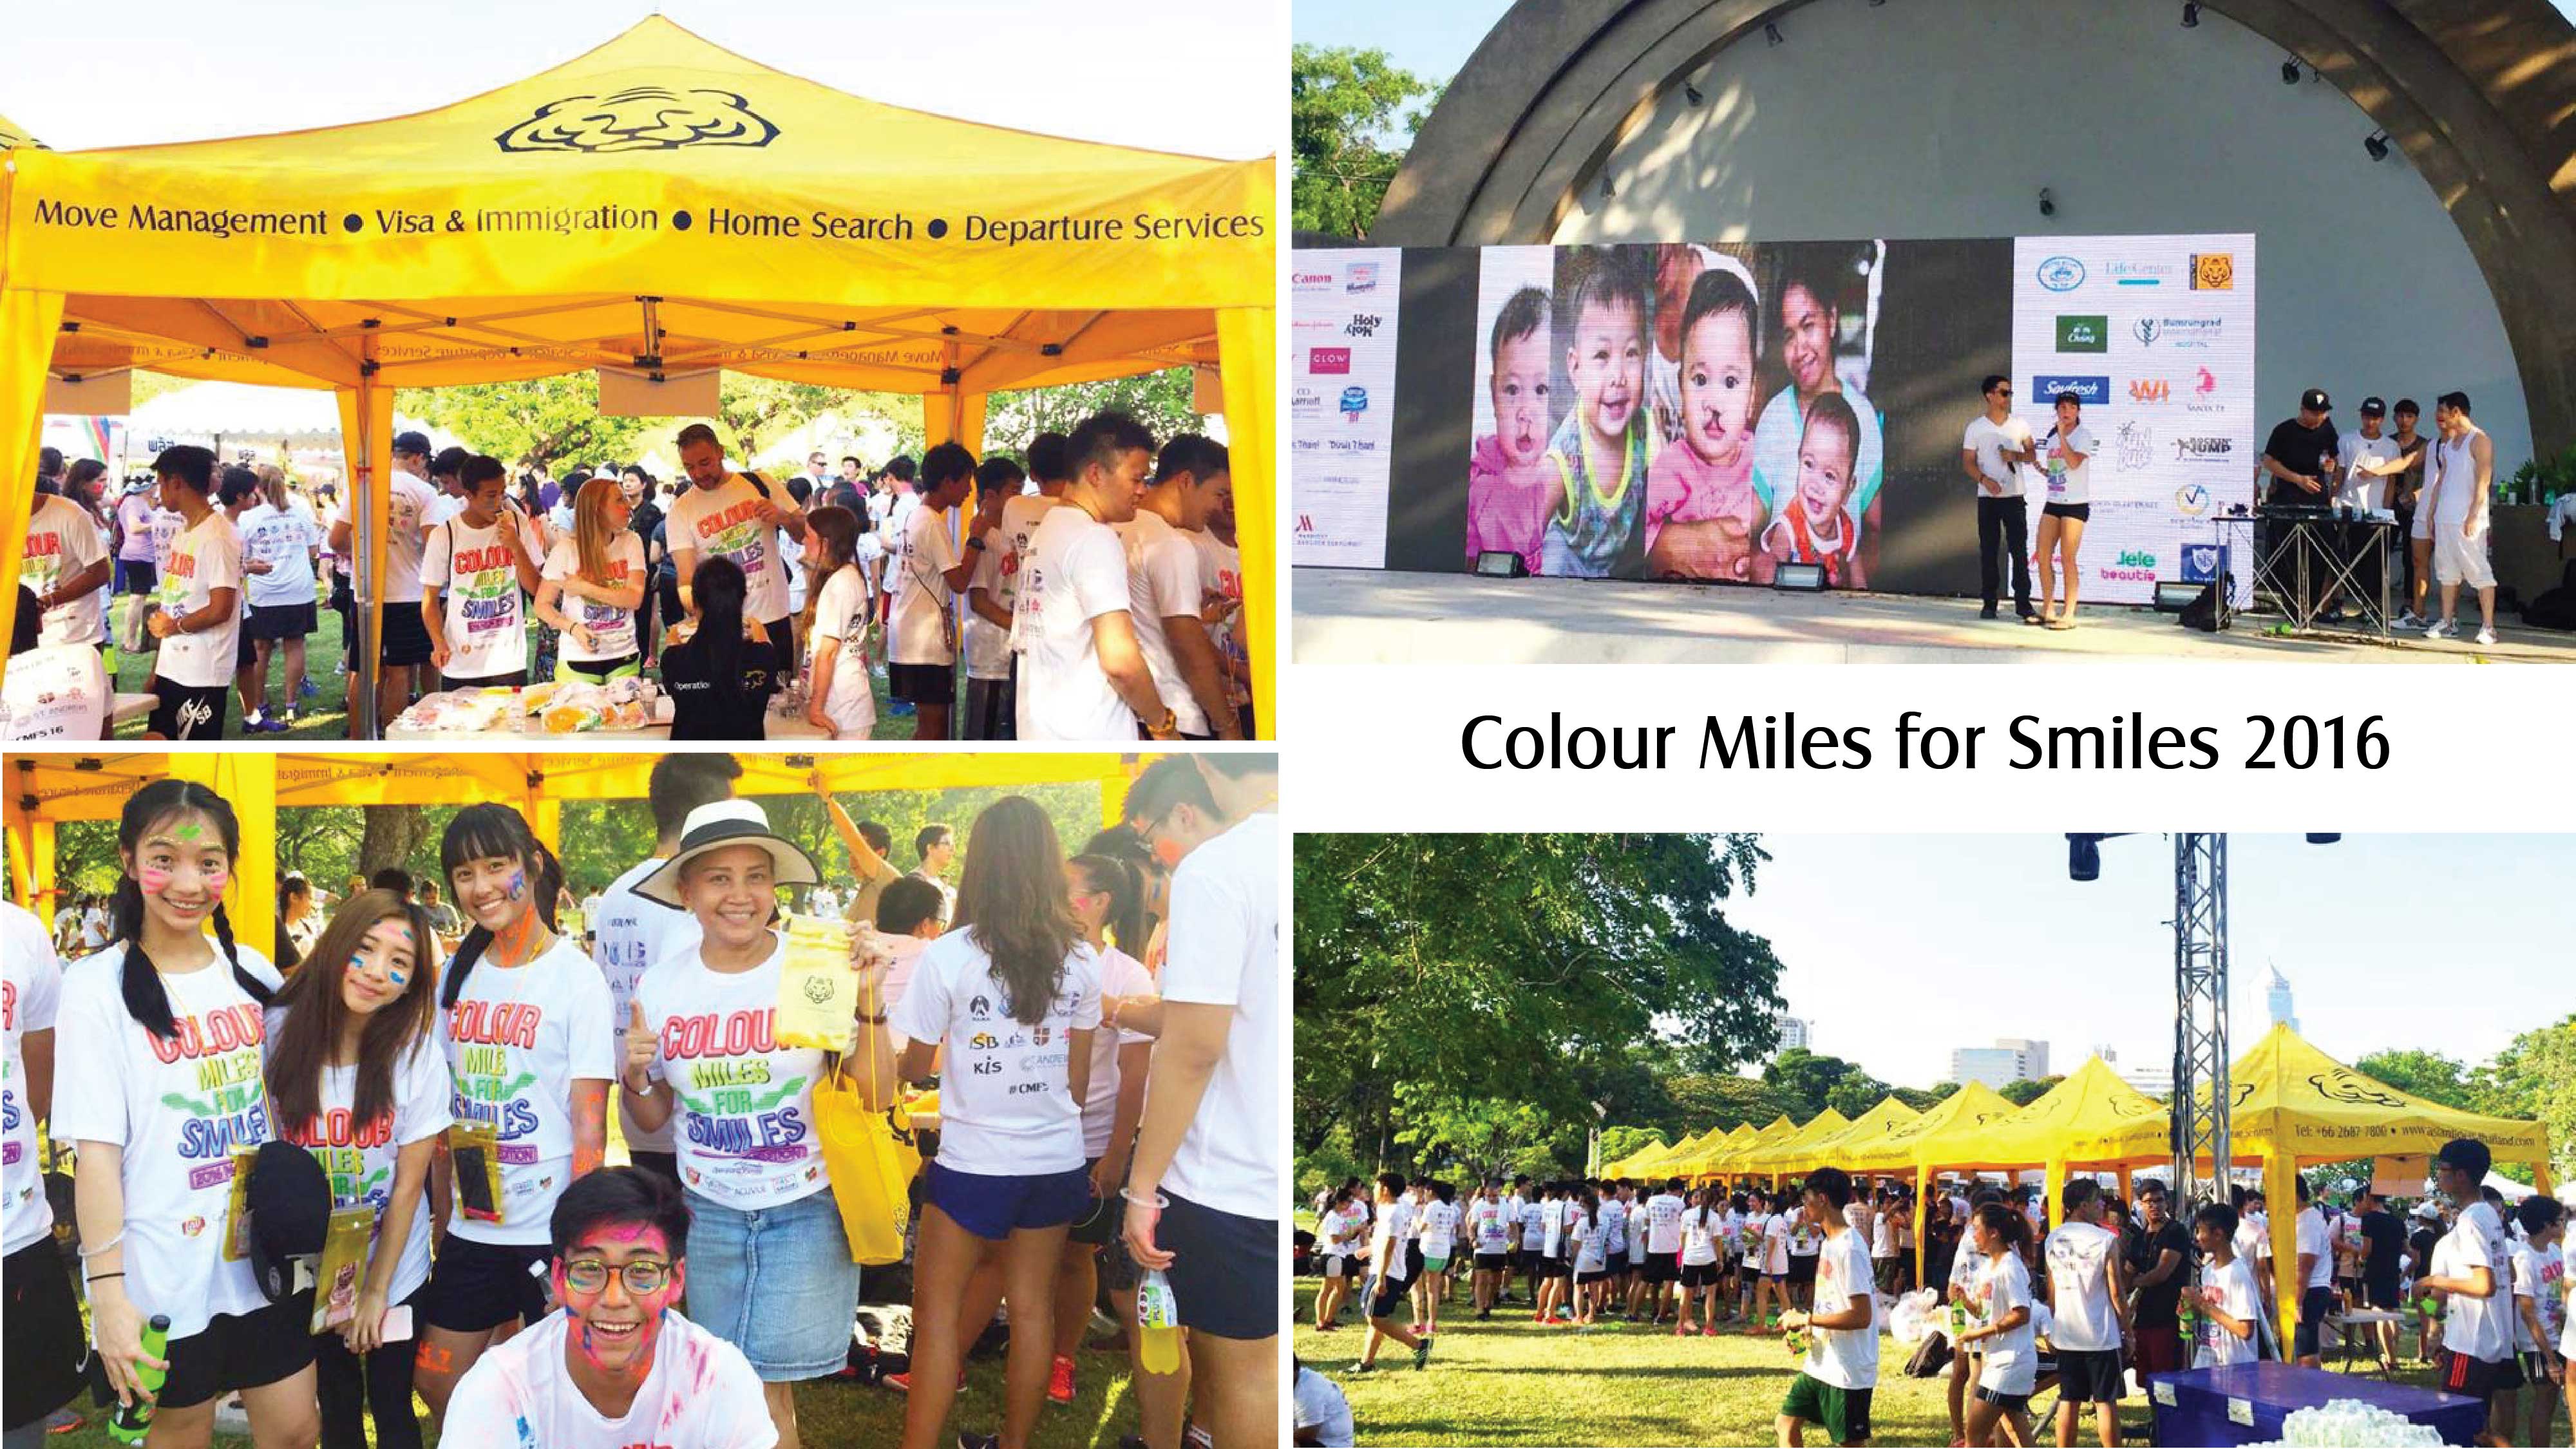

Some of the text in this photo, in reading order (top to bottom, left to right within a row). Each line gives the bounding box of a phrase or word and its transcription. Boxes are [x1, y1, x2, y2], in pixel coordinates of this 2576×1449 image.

[34, 199, 327, 238] Move Management
[375, 204, 658, 236] Visa & Immigration
[709, 207, 913, 241] Home Search
[965, 213, 1264, 247] Departure Services
[1353, 314, 1382, 328] Holy
[697, 498, 755, 539] COLOU
[2116, 549, 2157, 567] Jele
[661, 1007, 791, 1061] COLOU
[196, 1048, 258, 1091] MILES
[689, 1059, 771, 1090] MILES
[712, 1090, 753, 1115] FOR
[177, 1103, 267, 1159] SMILE
[685, 1106, 808, 1155] SMILES
[2295, 1124, 2313, 1137] Tel:
